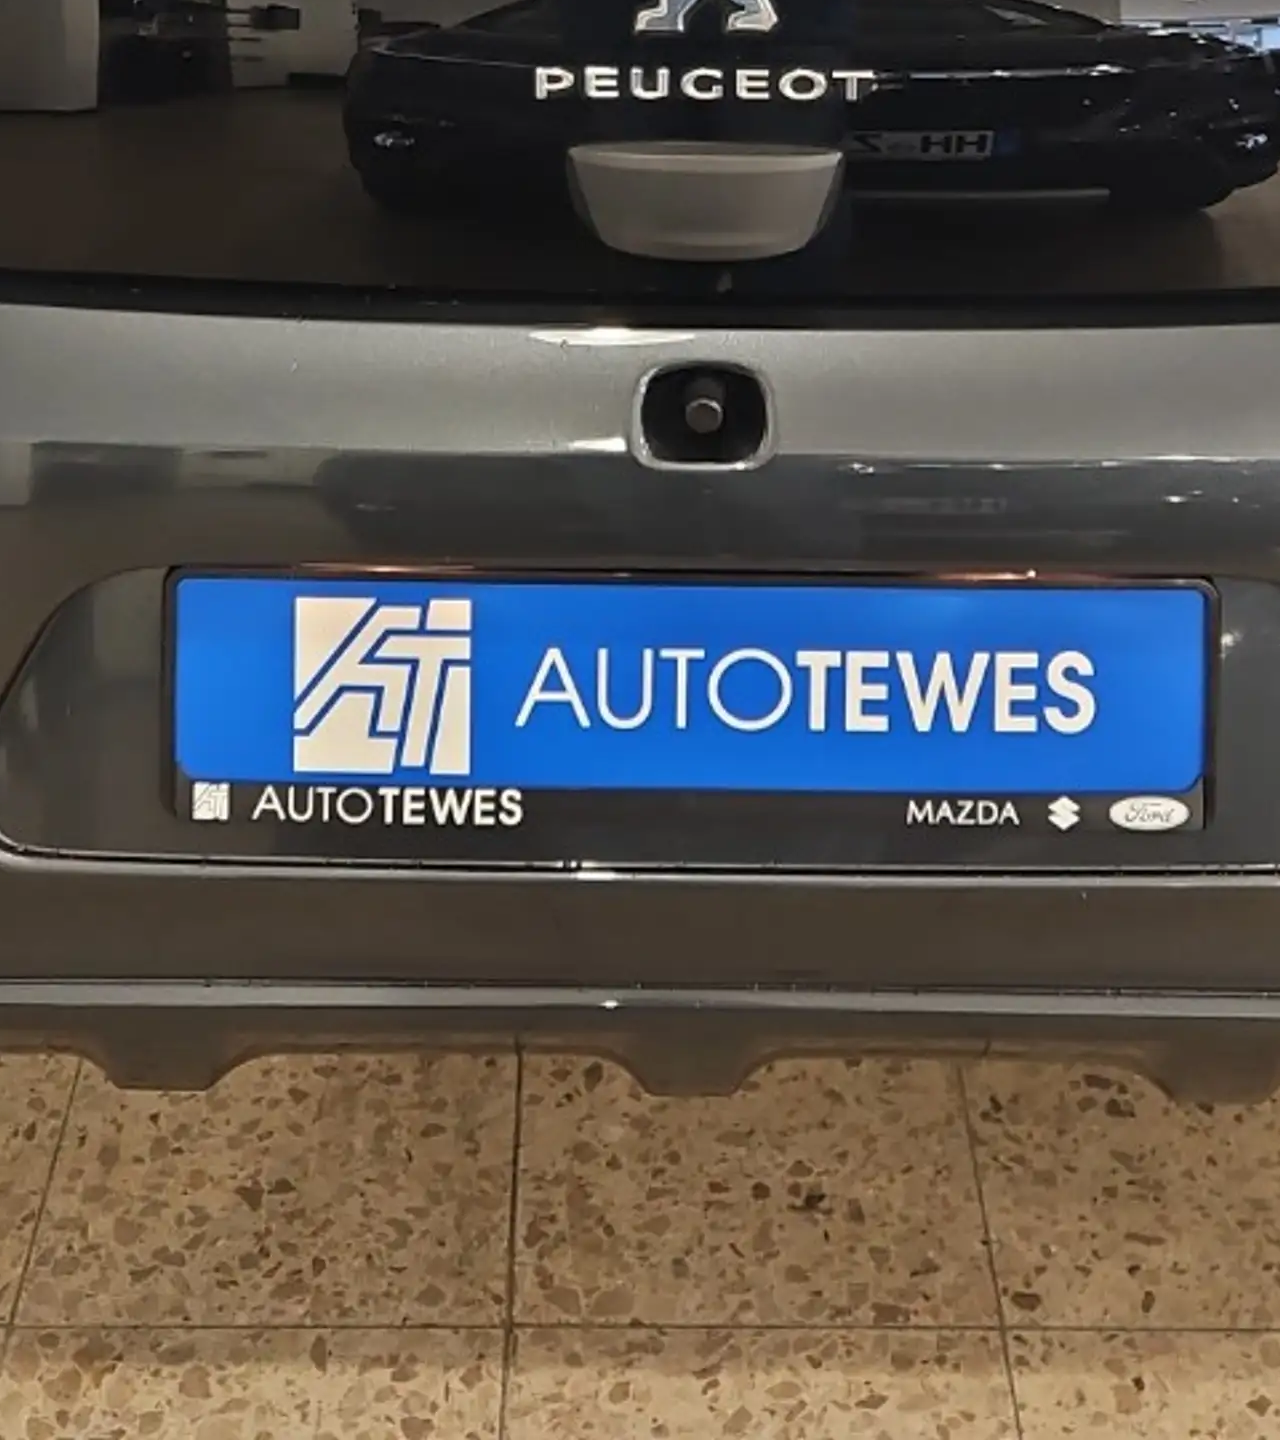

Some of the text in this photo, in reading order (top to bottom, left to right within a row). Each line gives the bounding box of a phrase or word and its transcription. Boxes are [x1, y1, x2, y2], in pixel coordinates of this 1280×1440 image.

[533, 66, 876, 102] PEUGEOT
[514, 646, 1097, 735] AUTOTEWES
[250, 784, 524, 826] AUTOTEWES
[906, 799, 1021, 827] MAZDA
[1122, 801, 1177, 824] Ford
